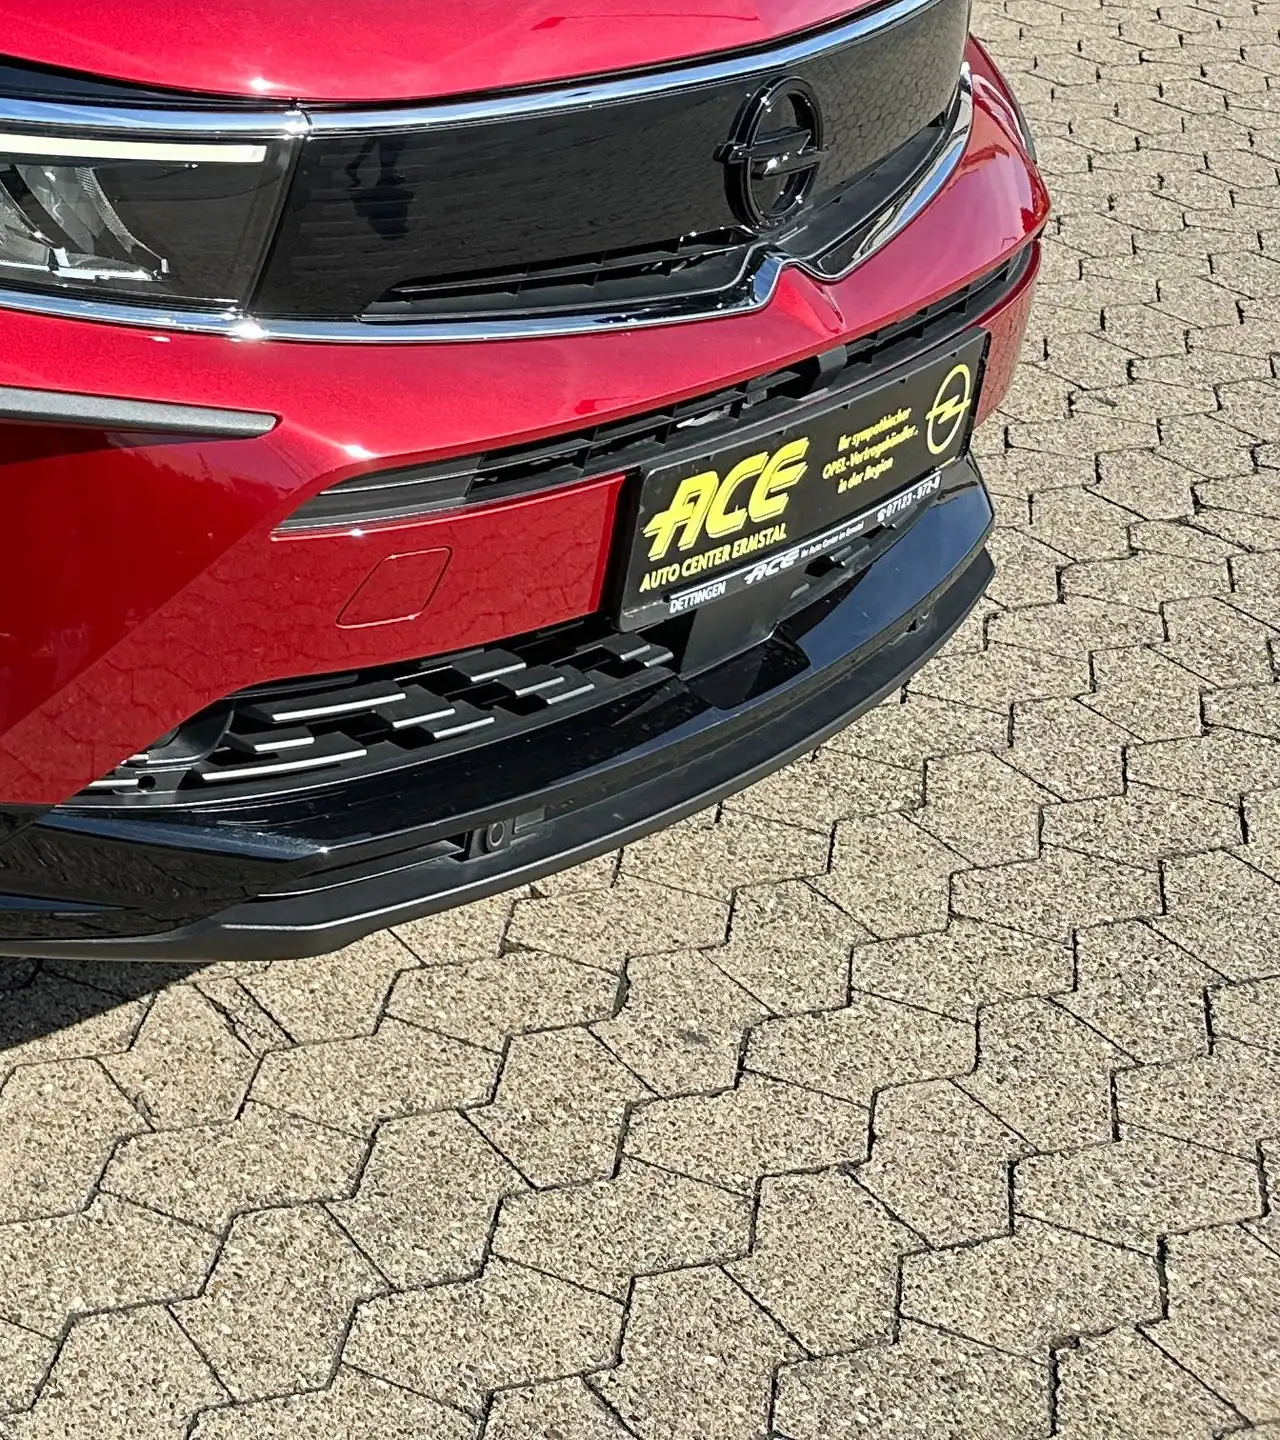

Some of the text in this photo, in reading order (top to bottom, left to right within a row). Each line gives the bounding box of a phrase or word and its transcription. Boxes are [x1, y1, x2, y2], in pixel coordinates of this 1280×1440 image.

[642, 436, 810, 562] ACE
[639, 522, 787, 593] AUTO CENTER ERMSTAL
[744, 547, 800, 585] ACE
[669, 581, 727, 613] DETTINGEN
